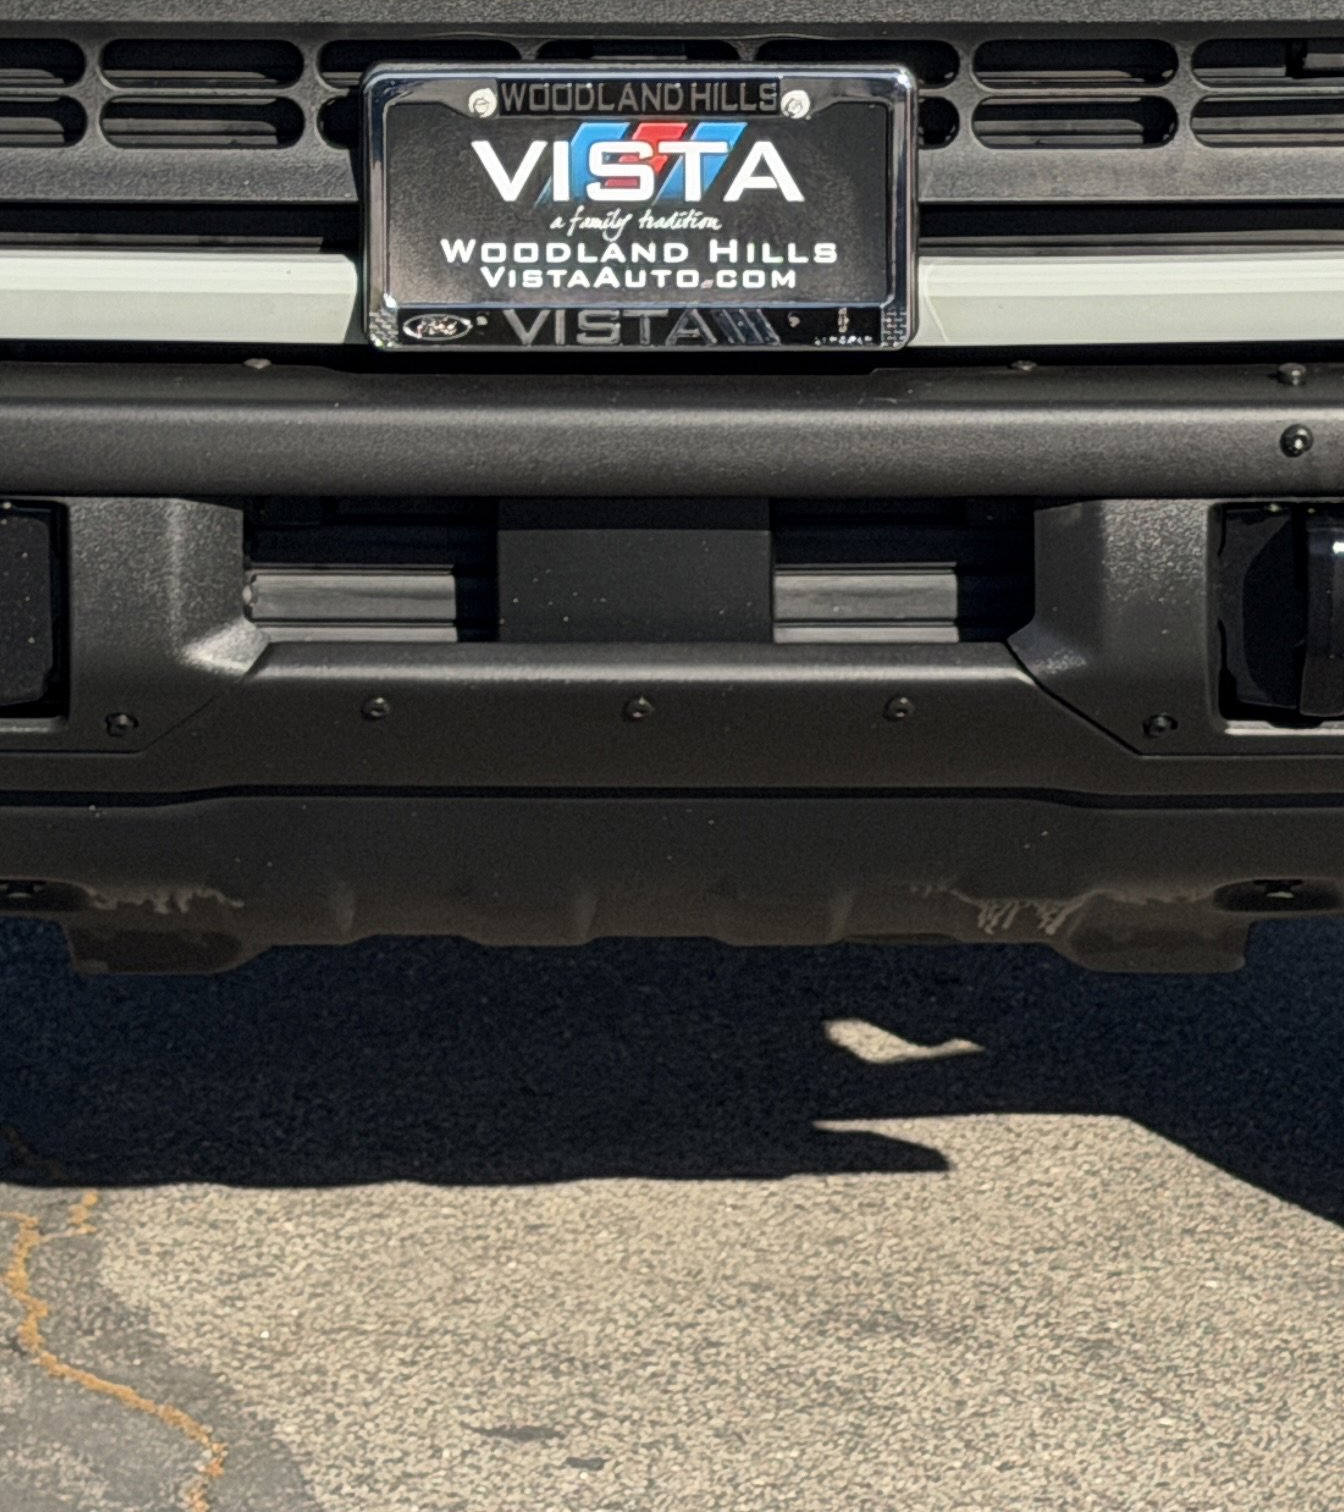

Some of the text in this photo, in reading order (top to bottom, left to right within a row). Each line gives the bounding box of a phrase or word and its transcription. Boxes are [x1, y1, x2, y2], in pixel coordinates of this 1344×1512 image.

[502, 82, 779, 113] WOODLAND HILLS
[471, 140, 805, 203] VISTA
[549, 204, 723, 242] a family tradition
[439, 238, 839, 264] WOODLAND HILLS
[502, 308, 717, 346] VISTA
